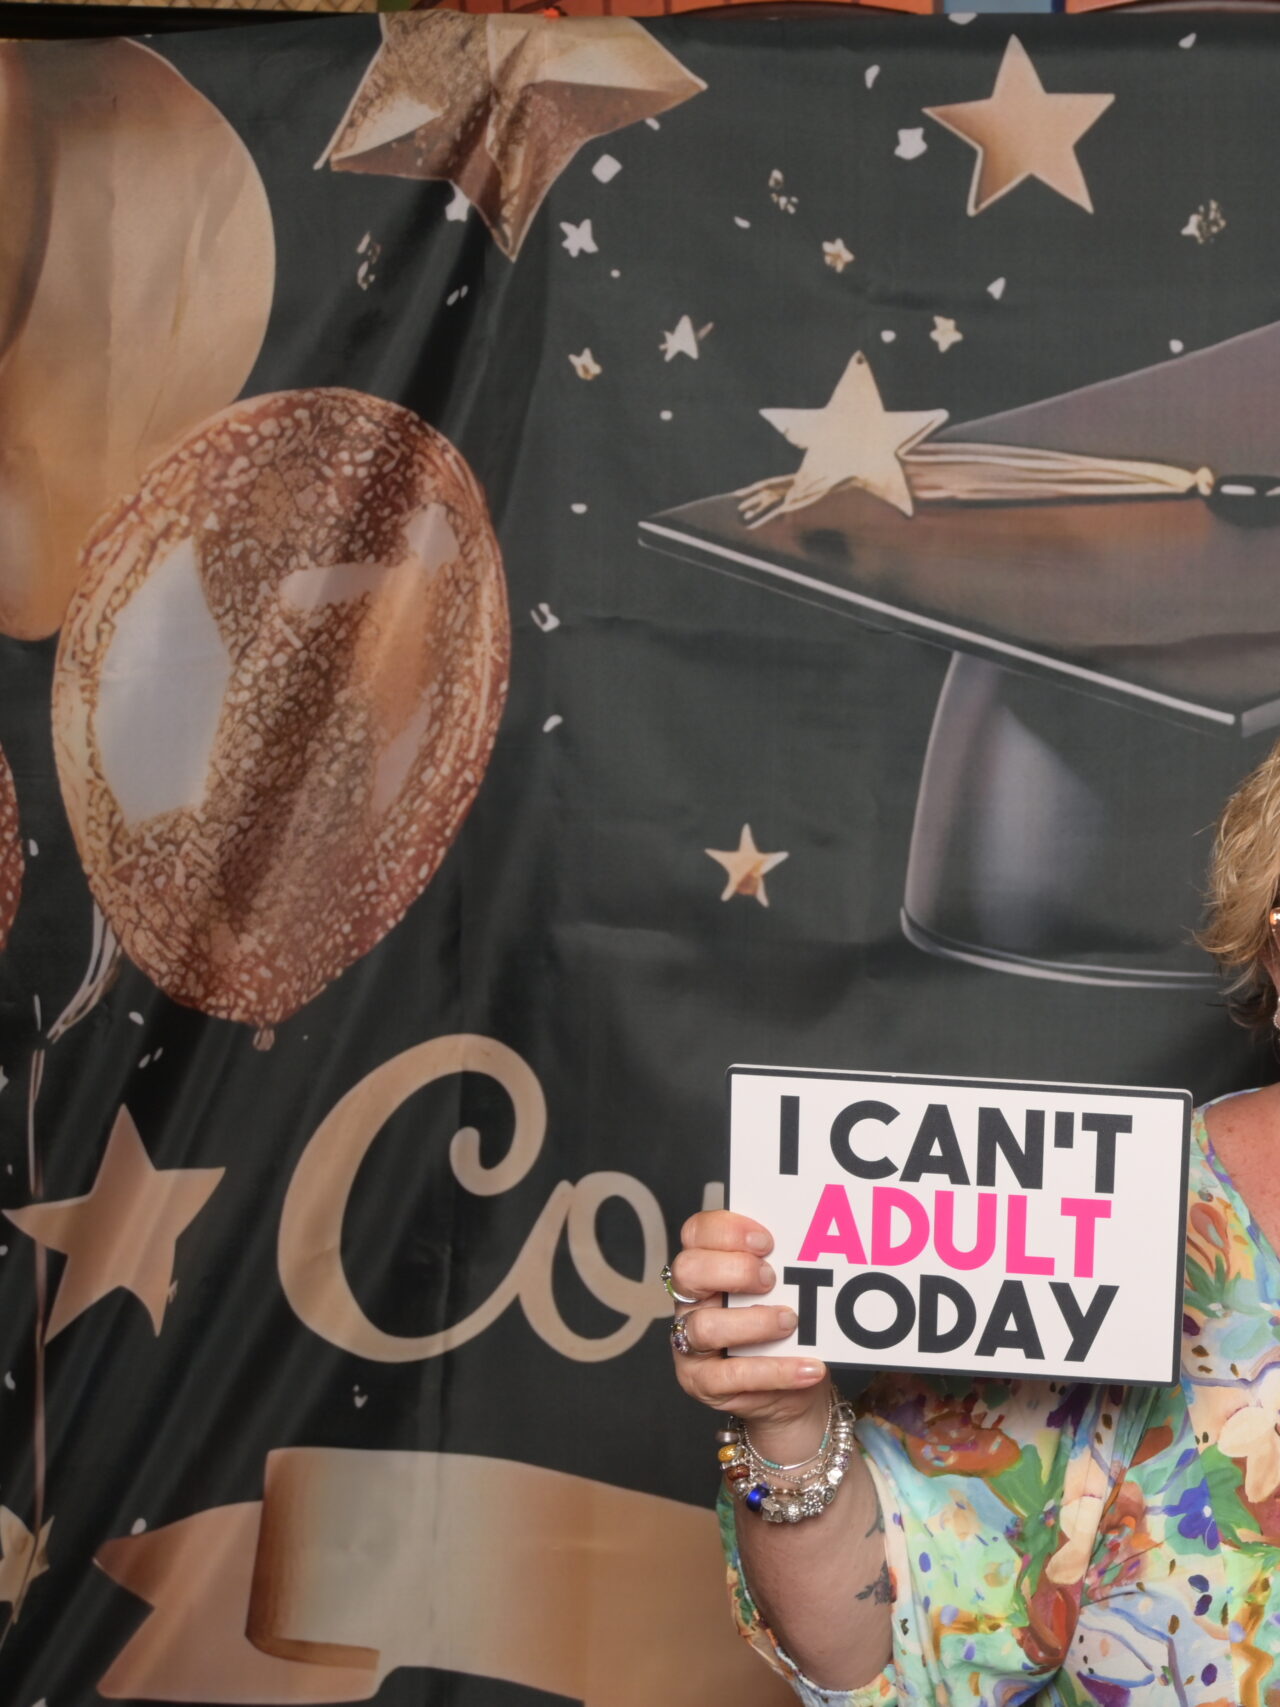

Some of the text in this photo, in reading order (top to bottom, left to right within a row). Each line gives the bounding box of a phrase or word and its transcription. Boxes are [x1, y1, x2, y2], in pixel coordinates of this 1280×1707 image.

[779, 1095, 1133, 1194] I CAN'T
[277, 1033, 725, 1363] Co
[796, 1184, 1112, 1278] ADULT
[783, 1267, 1120, 1362] TODAY
